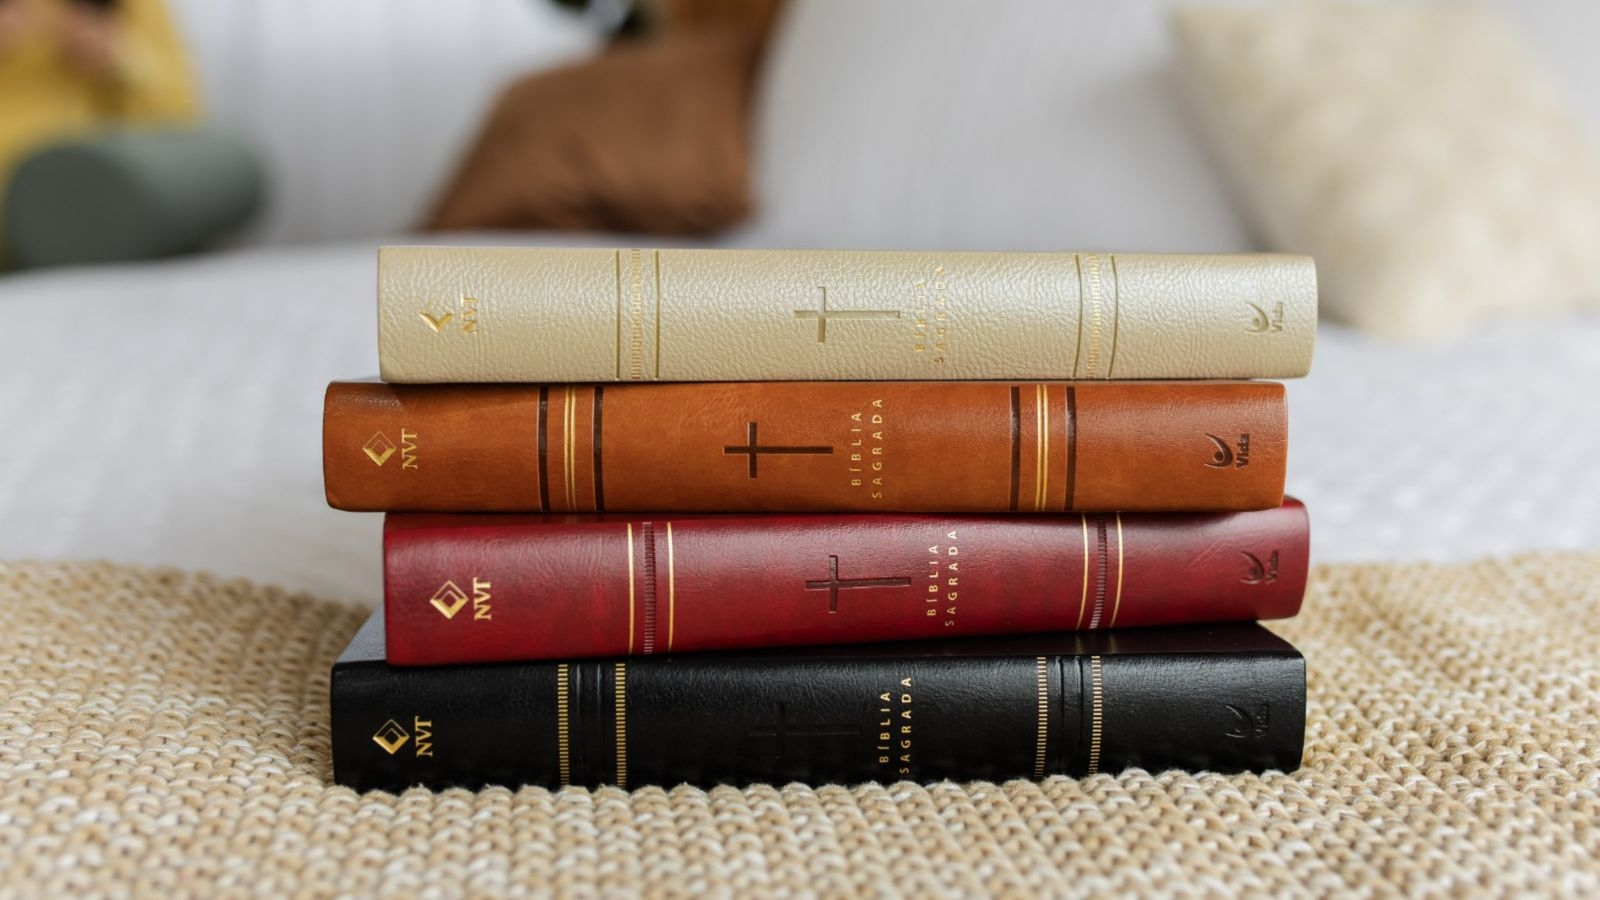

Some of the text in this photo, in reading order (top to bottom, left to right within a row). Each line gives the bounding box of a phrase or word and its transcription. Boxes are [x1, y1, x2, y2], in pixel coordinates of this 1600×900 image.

[460, 292, 478, 335] NVT
[913, 278, 926, 353] BÍBLIA
[933, 264, 947, 364] SAGRADA
[1271, 300, 1284, 332] Vida
[401, 428, 418, 470] NVT
[849, 411, 862, 486] BÍBLIA
[871, 399, 883, 499] SAGRADA
[1235, 432, 1250, 469] Vida
[472, 576, 492, 621] NVT
[926, 544, 940, 617] BÍBLIA
[944, 530, 959, 627] SAGRADA
[415, 716, 433, 758] NVT
[877, 691, 891, 763] BÍBLIA
[899, 677, 912, 774] SAGRADA
